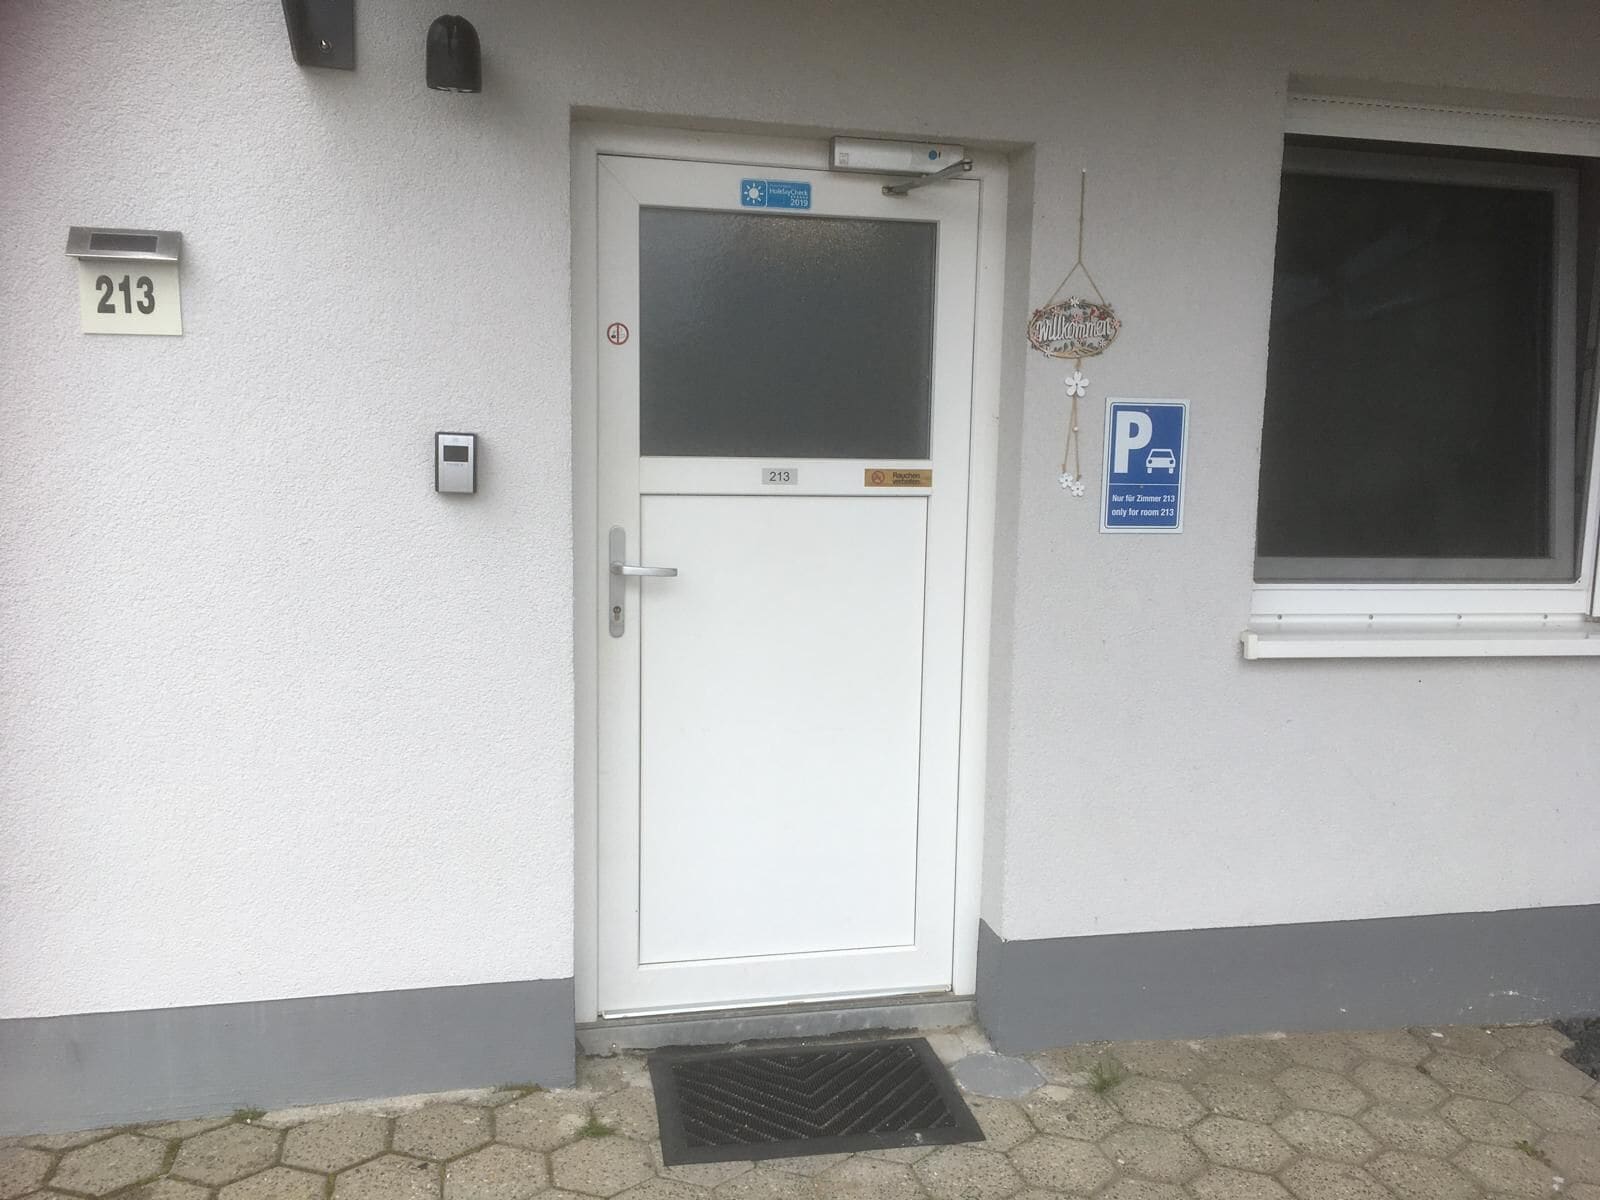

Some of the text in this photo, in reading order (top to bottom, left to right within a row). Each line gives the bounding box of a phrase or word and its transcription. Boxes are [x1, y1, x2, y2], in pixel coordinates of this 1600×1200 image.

[95, 275, 156, 315] 213
[1114, 410, 1153, 474] P
[769, 471, 790, 482] 213
[892, 471, 921, 480] Rauchen
[1112, 494, 1123, 502] Nur
[1125, 494, 1135, 502] für
[1136, 494, 1161, 502] Zimmer
[1111, 508, 1126, 517] only
[1128, 508, 1138, 516] for
[1160, 508, 1174, 516] 213
